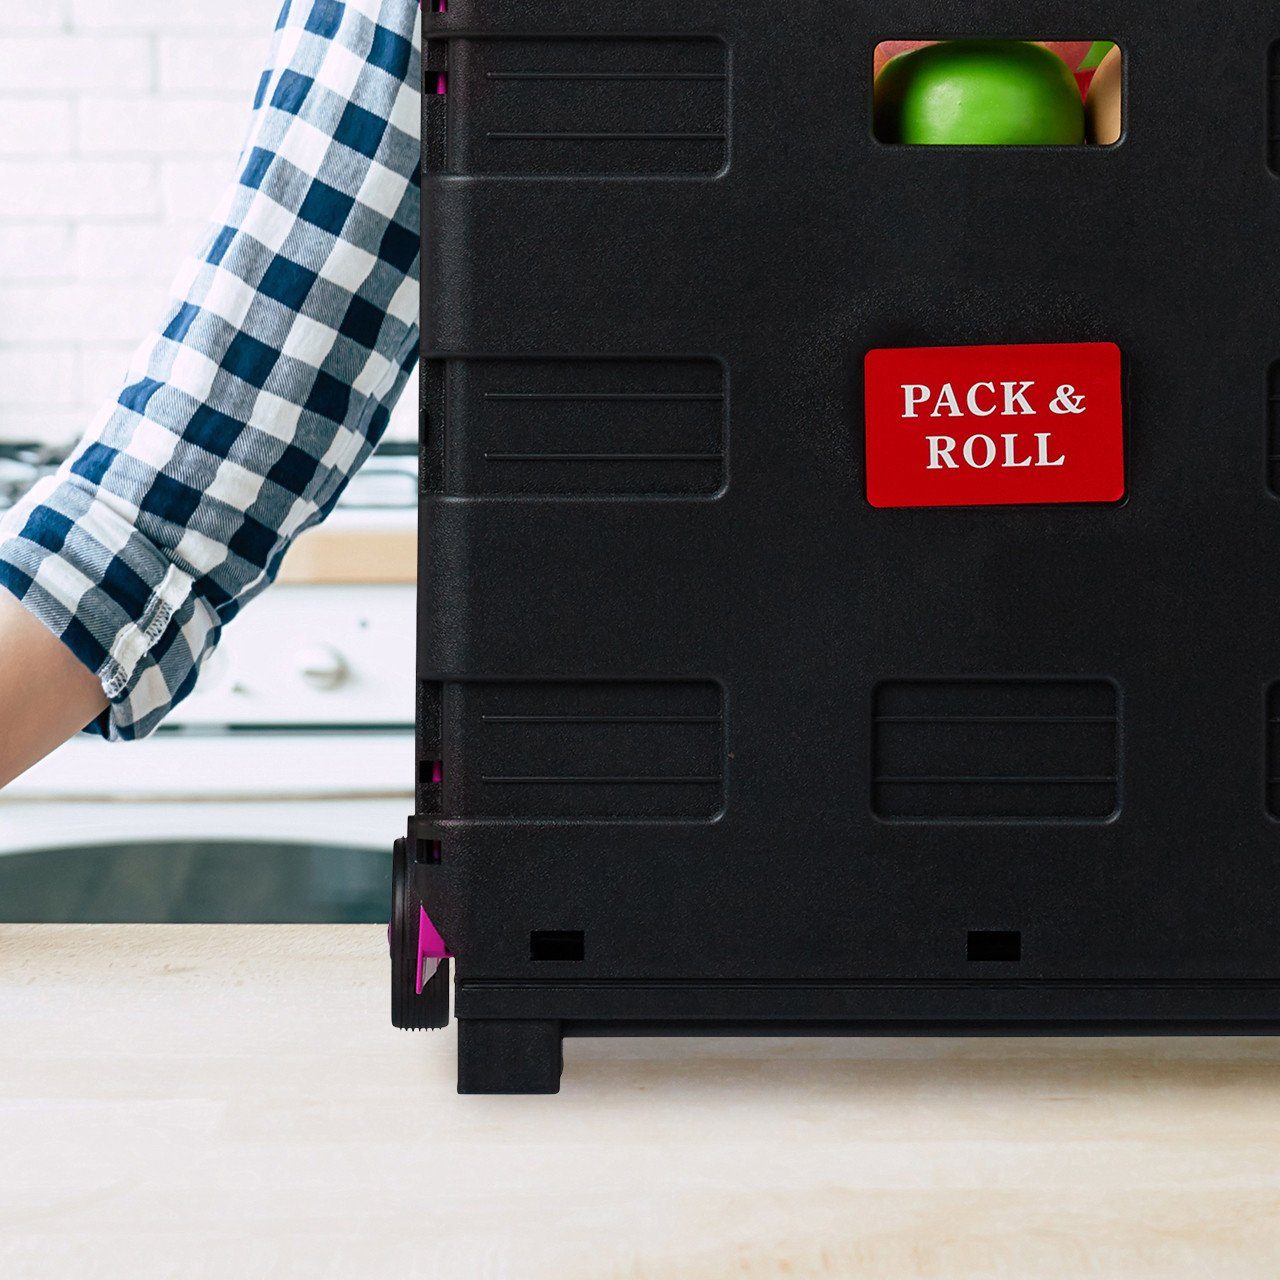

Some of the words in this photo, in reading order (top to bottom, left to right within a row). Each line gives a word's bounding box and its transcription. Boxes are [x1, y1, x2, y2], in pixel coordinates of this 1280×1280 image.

[900, 381, 1037, 418] PACK
[1048, 383, 1087, 415] &
[925, 432, 1066, 469] ROLL
